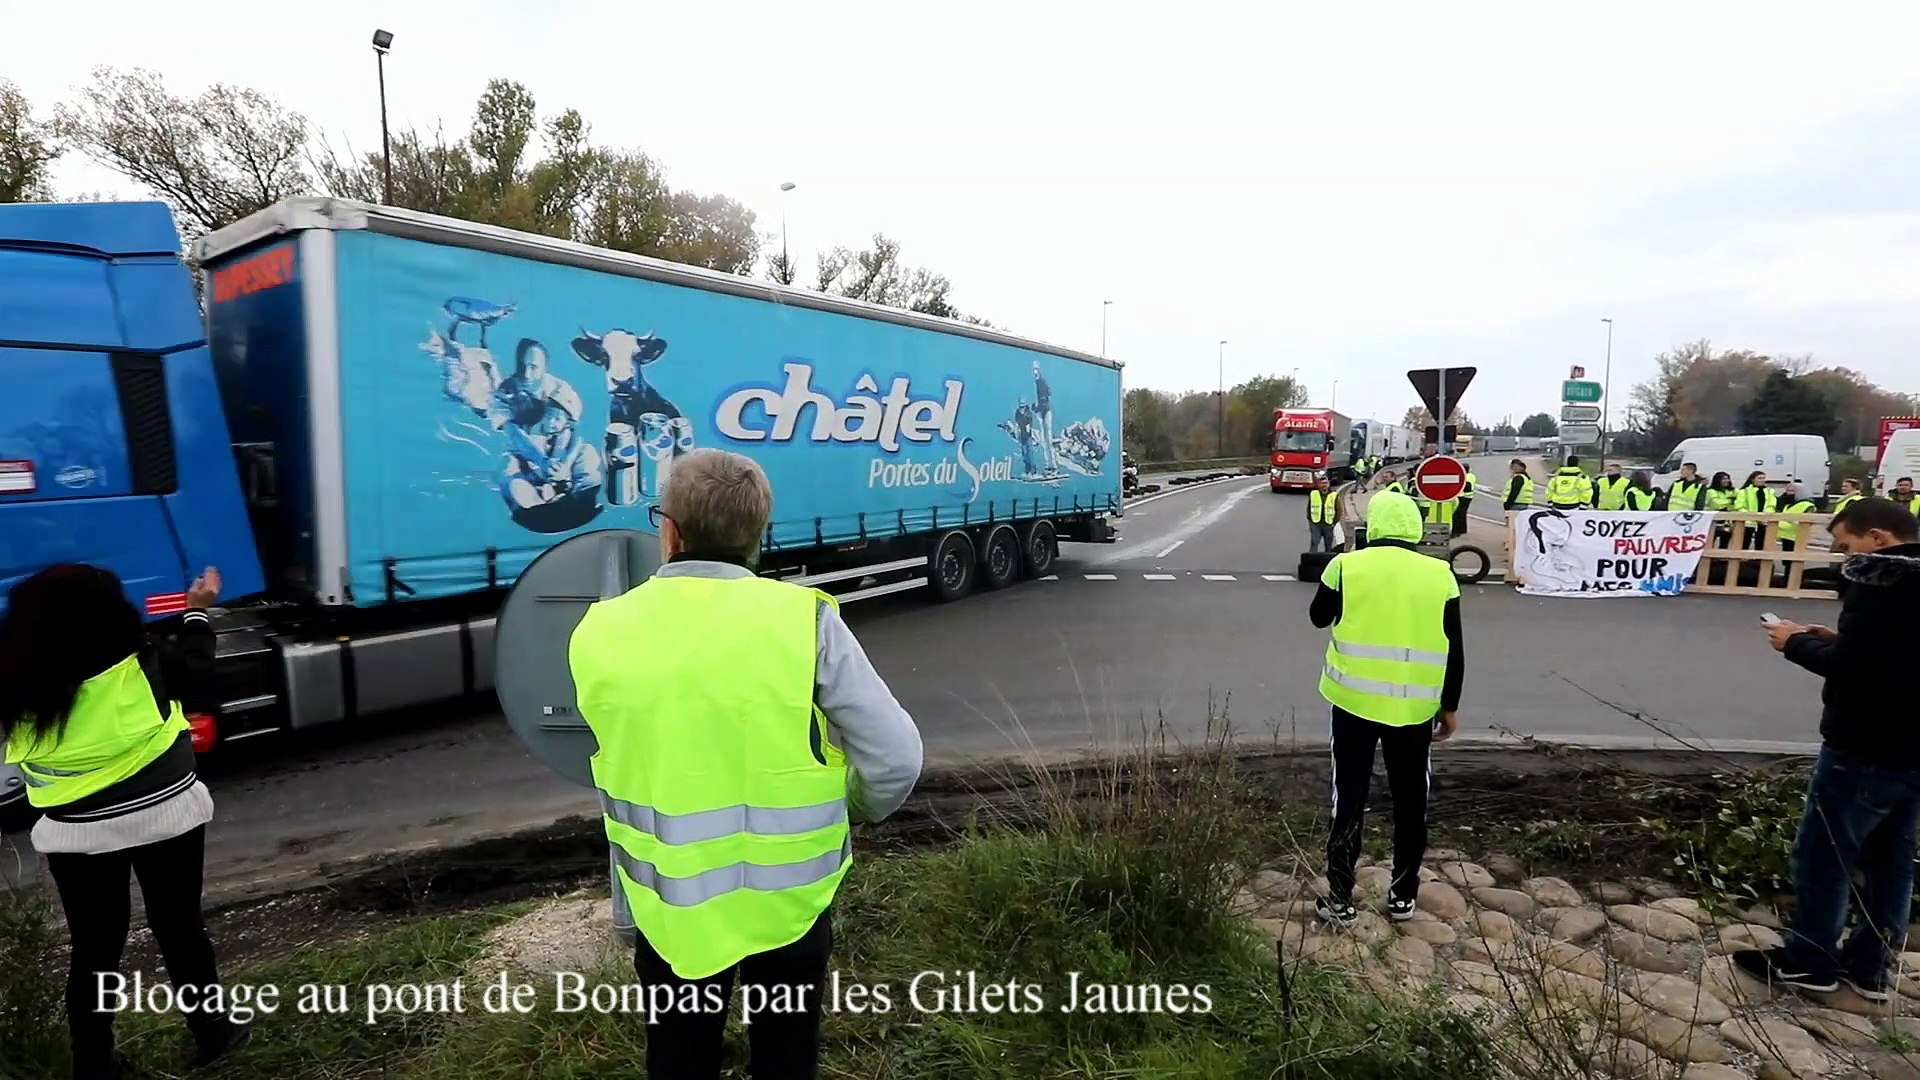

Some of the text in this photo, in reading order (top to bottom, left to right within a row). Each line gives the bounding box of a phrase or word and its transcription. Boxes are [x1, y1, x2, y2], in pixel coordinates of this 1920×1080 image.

[868, 436, 1012, 503] Portes du Soleil
[1582, 519, 1648, 538] SOYEZ
[1613, 533, 1707, 556] PAUVRES
[1596, 557, 1669, 580] POUR
